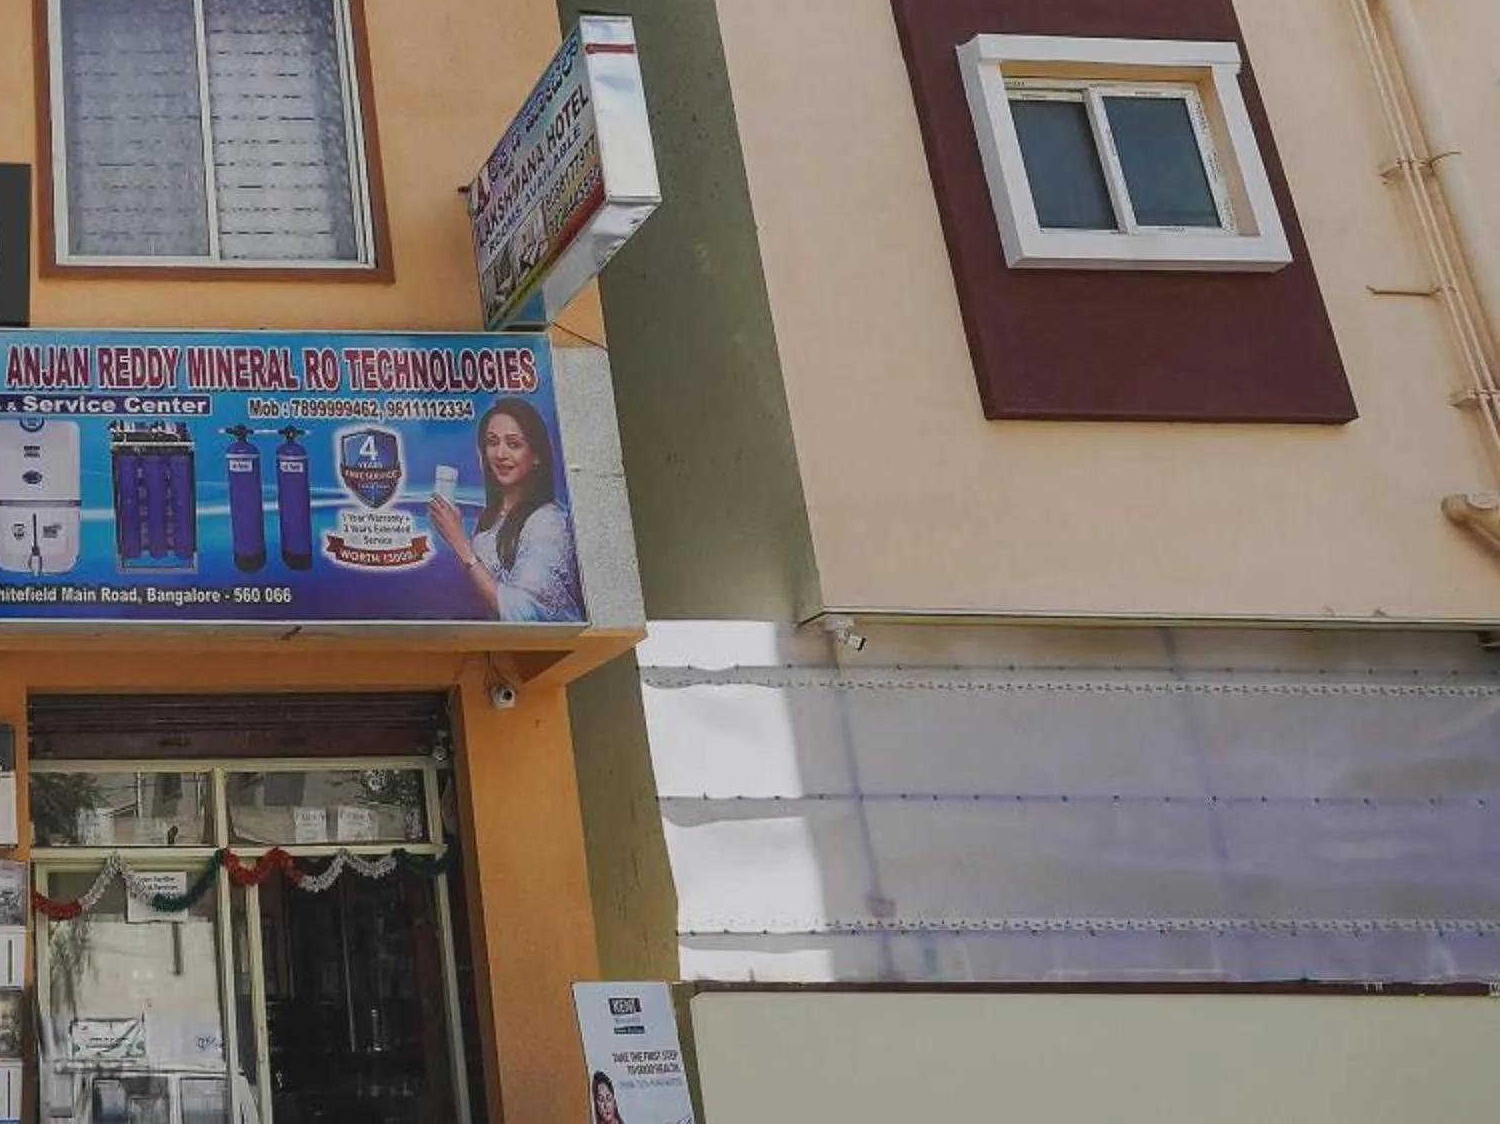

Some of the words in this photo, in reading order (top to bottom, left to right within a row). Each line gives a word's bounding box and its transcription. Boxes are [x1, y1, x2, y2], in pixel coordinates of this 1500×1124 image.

[478, 144, 545, 248] LAKSHMANA
[545, 84, 589, 151] HOTEL
[524, 125, 581, 208] AVAILABLE
[5, 346, 90, 388] ANJAN
[100, 347, 180, 388] REDDY
[187, 347, 299, 390] MINERAL
[304, 349, 338, 391] RO
[344, 349, 537, 392] TECHNOLOGIES
[6, 401, 17, 411] &
[23, 395, 117, 412] Service
[124, 397, 208, 414] Center
[359, 435, 379, 461] 4
[61, 587, 97, 603] Main
[101, 588, 143, 604] Road,
[147, 588, 220, 606] Bangalore
[233, 588, 260, 603] 560
[265, 588, 292, 603] 066
